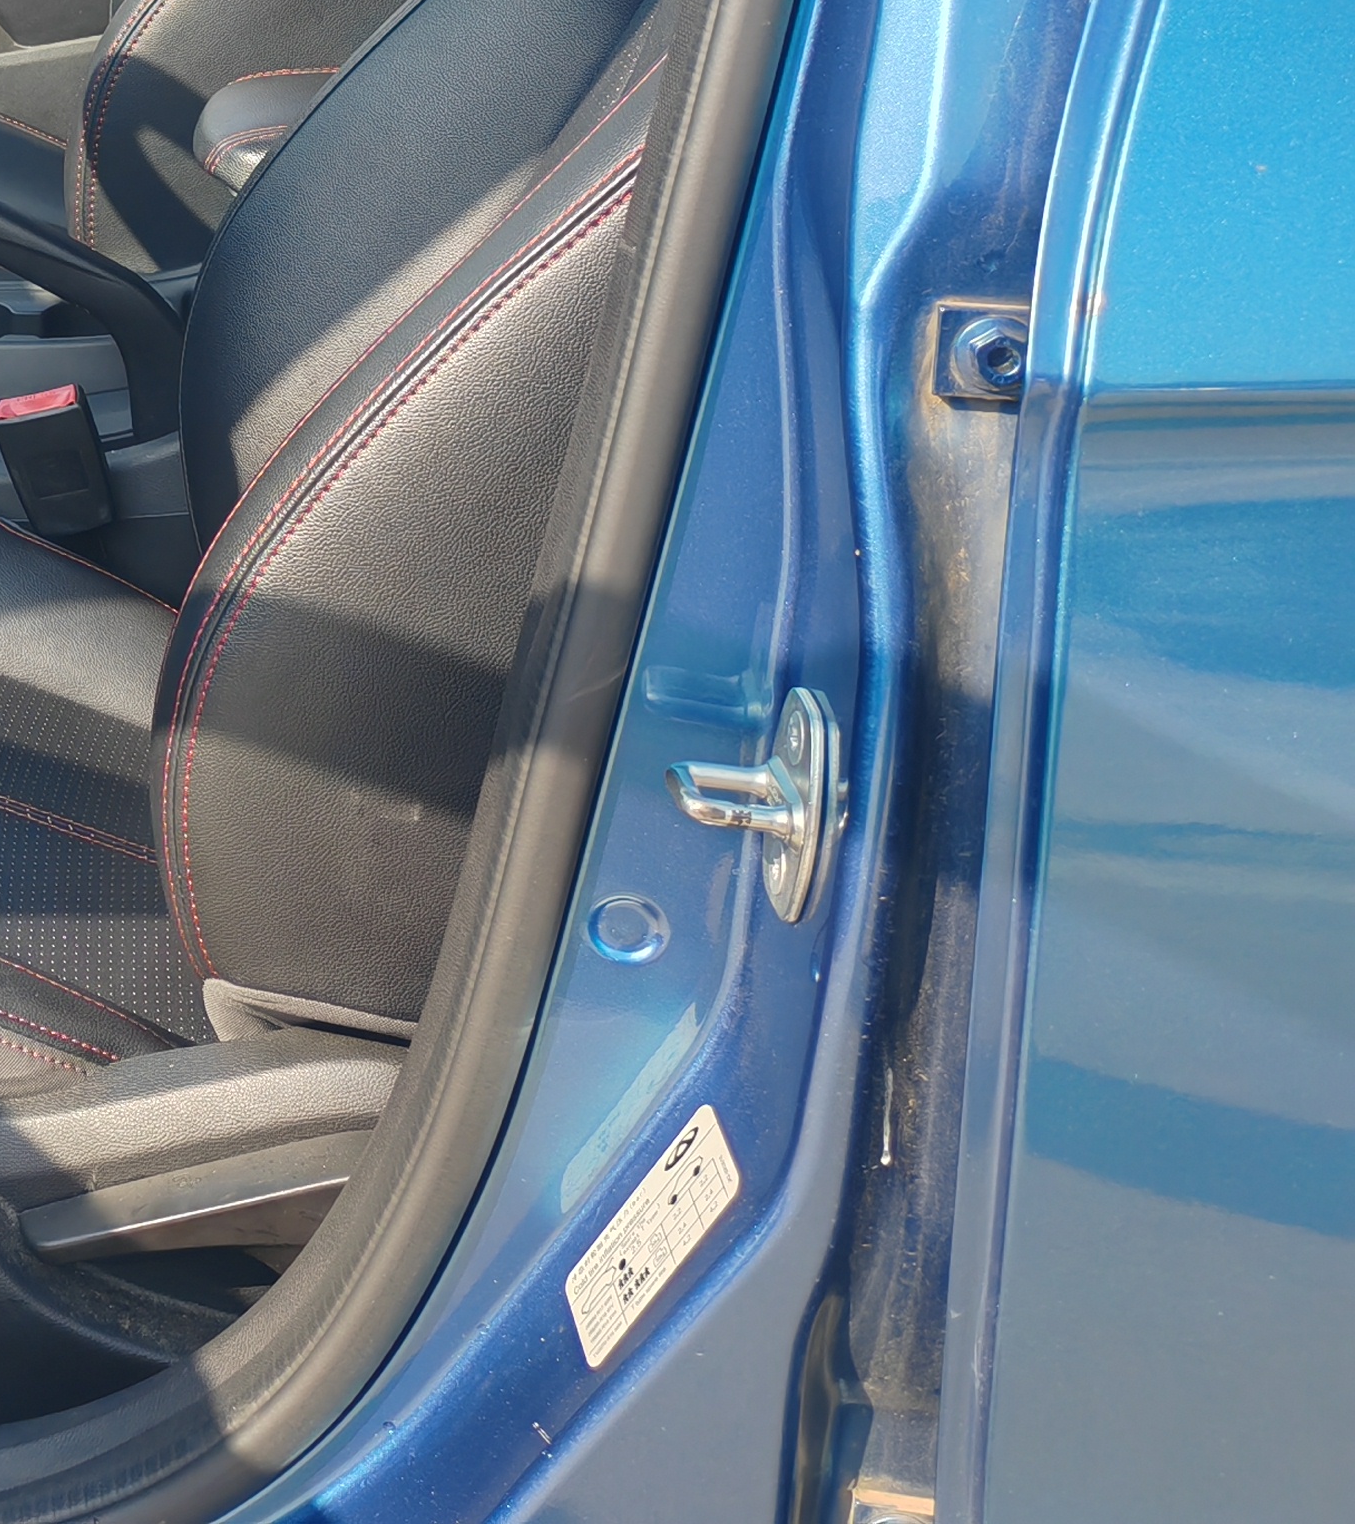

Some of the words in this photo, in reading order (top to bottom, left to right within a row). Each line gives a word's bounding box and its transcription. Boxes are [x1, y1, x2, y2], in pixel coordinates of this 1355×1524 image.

[574, 1275, 588, 1295] Cold
[588, 1263, 599, 1277] tire
[623, 1198, 650, 1234] pressure
